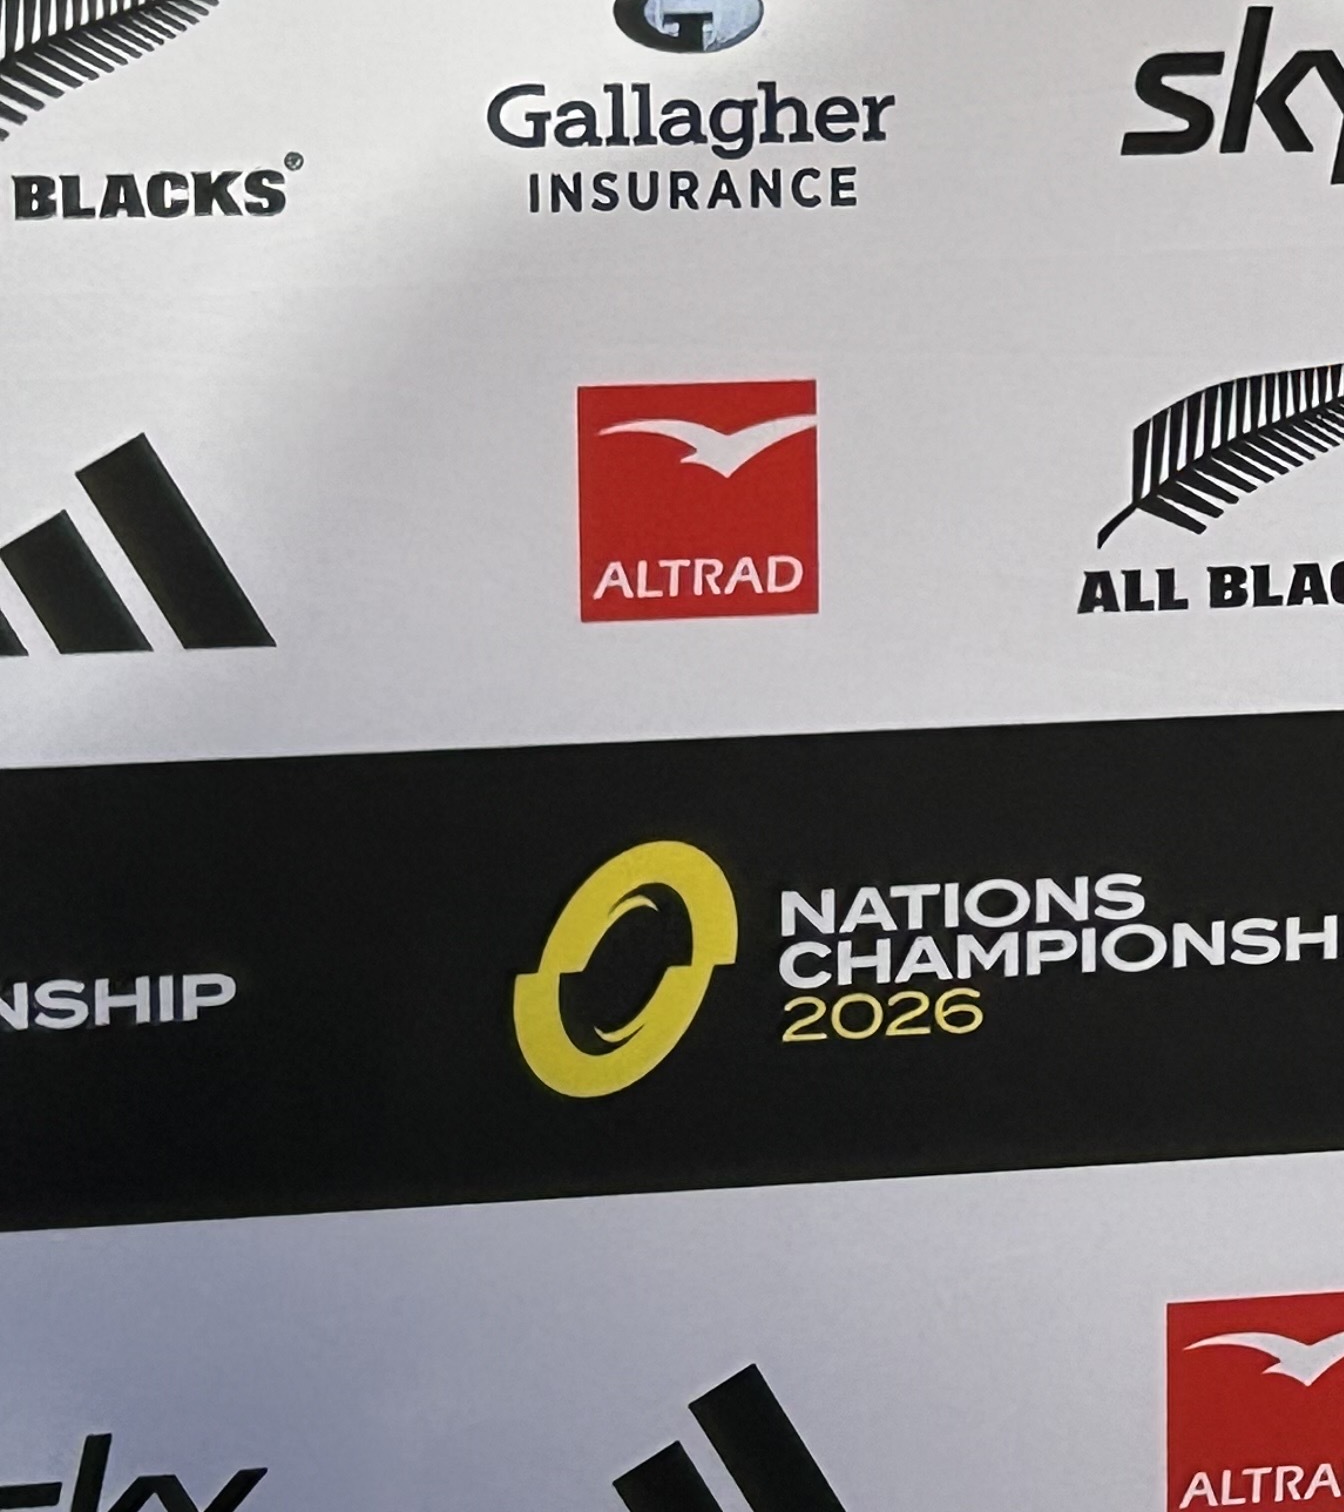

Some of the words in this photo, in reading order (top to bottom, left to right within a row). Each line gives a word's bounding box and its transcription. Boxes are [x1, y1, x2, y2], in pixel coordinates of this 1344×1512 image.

[486, 80, 896, 161] Gallagher
[11, 169, 286, 221] BLACKS
[529, 166, 857, 213] INSURANCE
[593, 555, 804, 600] ALTRAD
[1077, 567, 1189, 615] ALL
[780, 872, 1146, 937] NATIONS
[782, 982, 984, 1042] 2026
